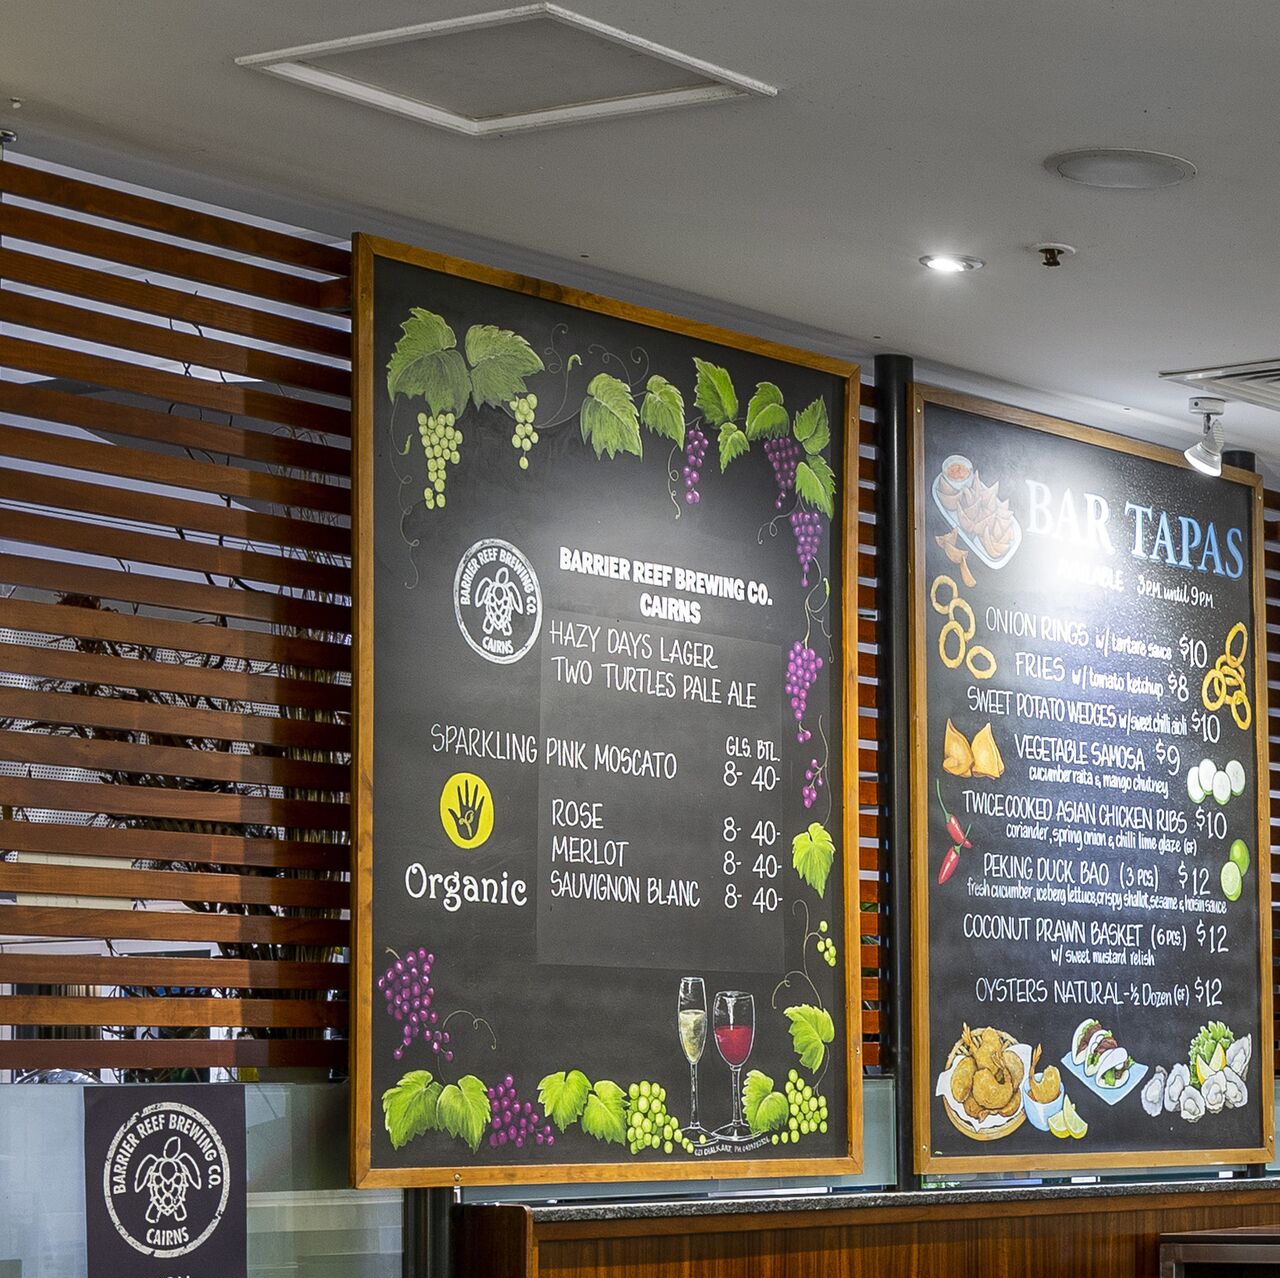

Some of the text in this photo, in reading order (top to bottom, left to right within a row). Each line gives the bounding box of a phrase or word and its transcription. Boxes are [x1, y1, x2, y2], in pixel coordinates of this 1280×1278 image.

[1025, 479, 1116, 556] BAR
[1124, 500, 1244, 581] TAPAS
[460, 548, 536, 615] BARRIER REEF BREWING CO.
[560, 546, 772, 605] BARRIER REEF BREWING CO.
[1137, 575, 1160, 599] 3PM
[1164, 585, 1189, 603] until
[1190, 586, 1215, 608] 9PM
[640, 593, 701, 624] CAIRNS
[482, 636, 513, 654] CAIRNS
[549, 620, 718, 669] HAZY DAYS LAGER
[985, 606, 1208, 668] ONION RINGS $10
[551, 657, 757, 709] TWO TURTLES PALE ALE
[1015, 652, 1189, 702] FRIES w/ tomato ketchup $8
[967, 686, 1013, 715] SWEET
[1016, 692, 1065, 721] POTATO
[1067, 700, 1116, 728] WEDGES
[1153, 713, 1170, 735] chilli
[1171, 714, 1187, 735] aioli
[1191, 709, 1220, 743] $10
[430, 723, 537, 764] SPARKLING
[546, 738, 587, 771] PINK
[595, 744, 677, 780] MOSCATO
[726, 736, 780, 762] GLS. BTL.
[1014, 734, 1180, 776] VEGETABLE SAMOSA $9
[1029, 764, 1168, 799] cucumber raita mango chutney
[552, 799, 603, 830] ROSE
[962, 790, 1227, 840] TWICE COOKED ASIAN CHICKEN RIBS $10
[552, 836, 629, 868] MERLOT
[1052, 825, 1082, 851] spring
[1084, 828, 1106, 846] onion
[1116, 830, 1136, 849] chilli
[1139, 831, 1157, 850] lime
[1158, 834, 1181, 855] glaze
[405, 863, 527, 912] Organic
[550, 872, 700, 907] SAUVIGNON BLANC
[984, 852, 1033, 880] PEKING
[1037, 857, 1075, 884] DUCK
[1081, 860, 1109, 886] BAO
[1178, 860, 1210, 896] $12
[967, 877, 990, 897] fresh
[1036, 883, 1066, 906] iceberg
[1150, 895, 1178, 910] sesame
[1205, 900, 1227, 914] sauce
[964, 913, 1032, 940] COCONUT
[1036, 918, 1086, 944] PRAWN
[1091, 922, 1143, 947] BASKET
[1196, 919, 1229, 953] $12
[1051, 948, 1155, 967] w/ sweet mustard relish
[976, 977, 1048, 1002] OYSTERS
[1054, 979, 1124, 1005] NATURAL
[1142, 983, 1172, 1007] Dozen
[1195, 976, 1223, 1007] $12
[114, 1114, 221, 1195] BARRIER REEF BREWING CO.
[146, 1226, 189, 1246] CAIRNS
